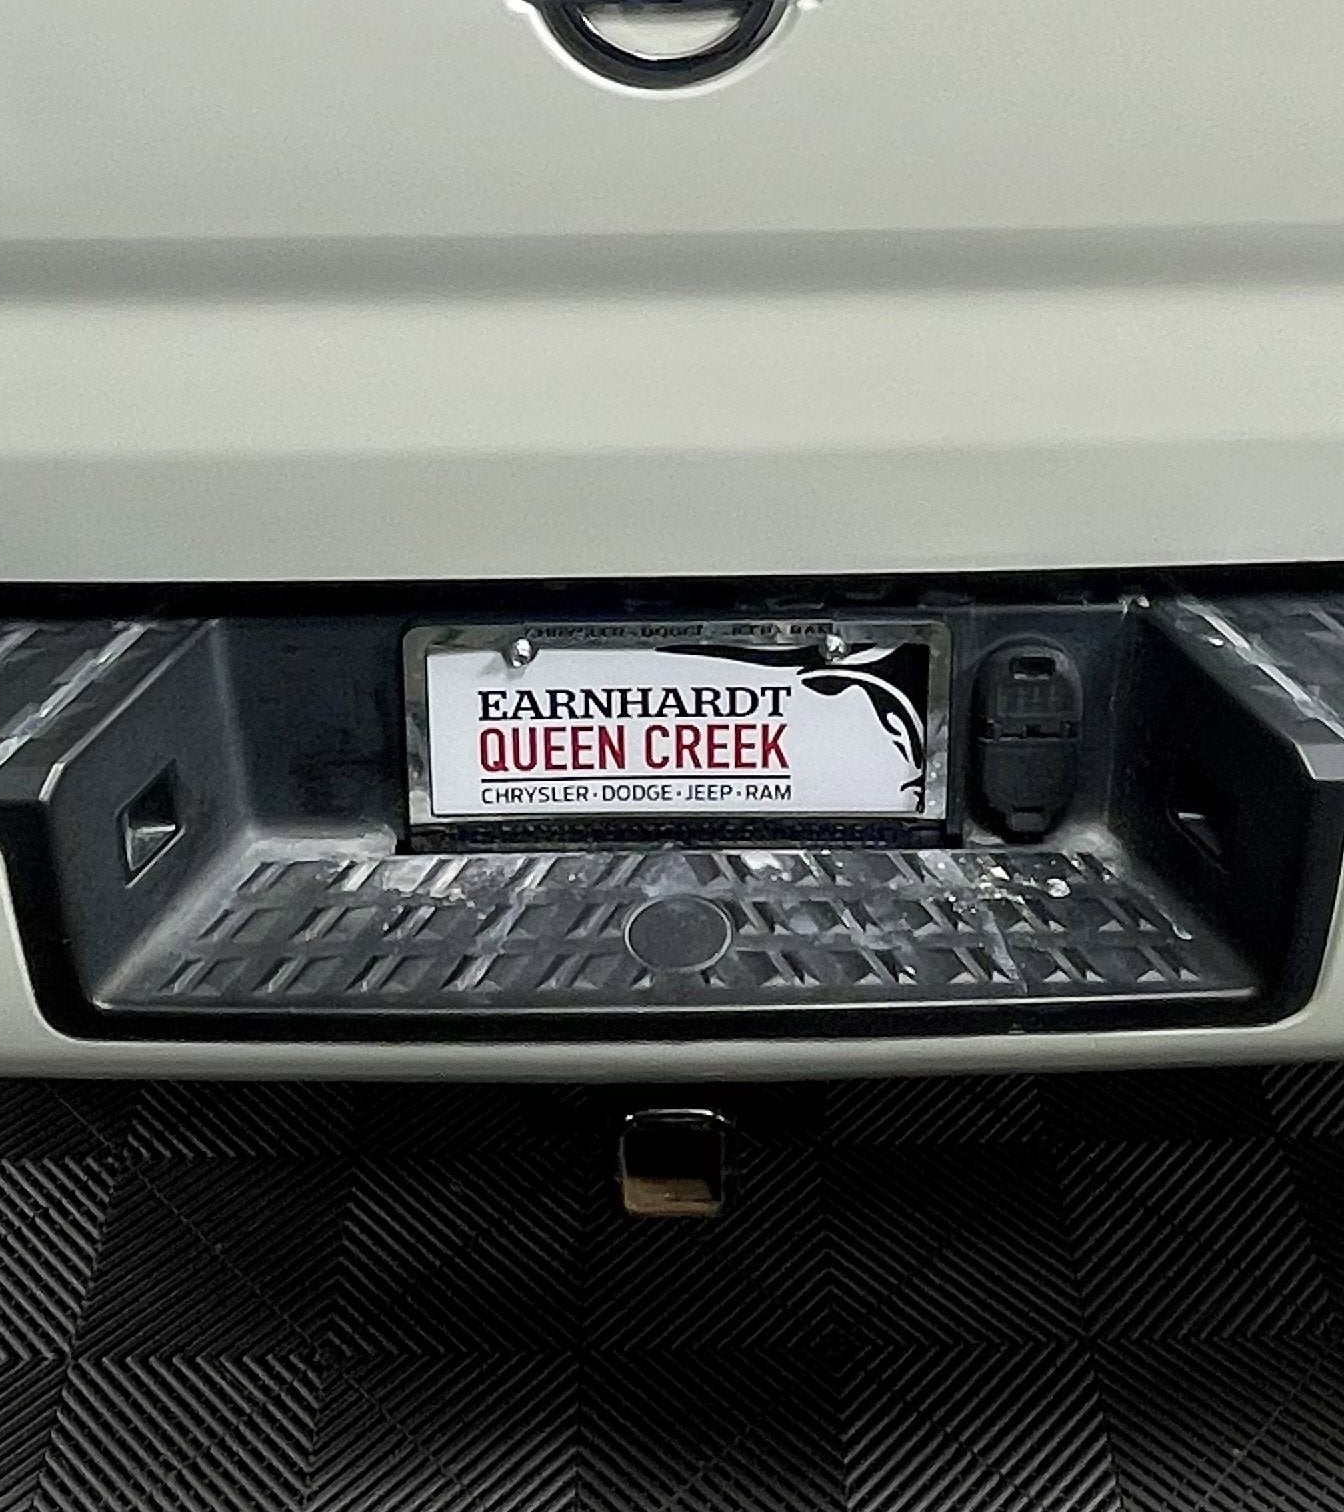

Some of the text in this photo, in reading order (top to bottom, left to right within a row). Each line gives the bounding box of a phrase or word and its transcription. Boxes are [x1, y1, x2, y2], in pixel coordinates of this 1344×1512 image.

[478, 686, 792, 721] EARNHARDT
[479, 723, 790, 773] QUEEN CREEK
[481, 784, 792, 804] CHRYSLER DODGE JEEP RAM
